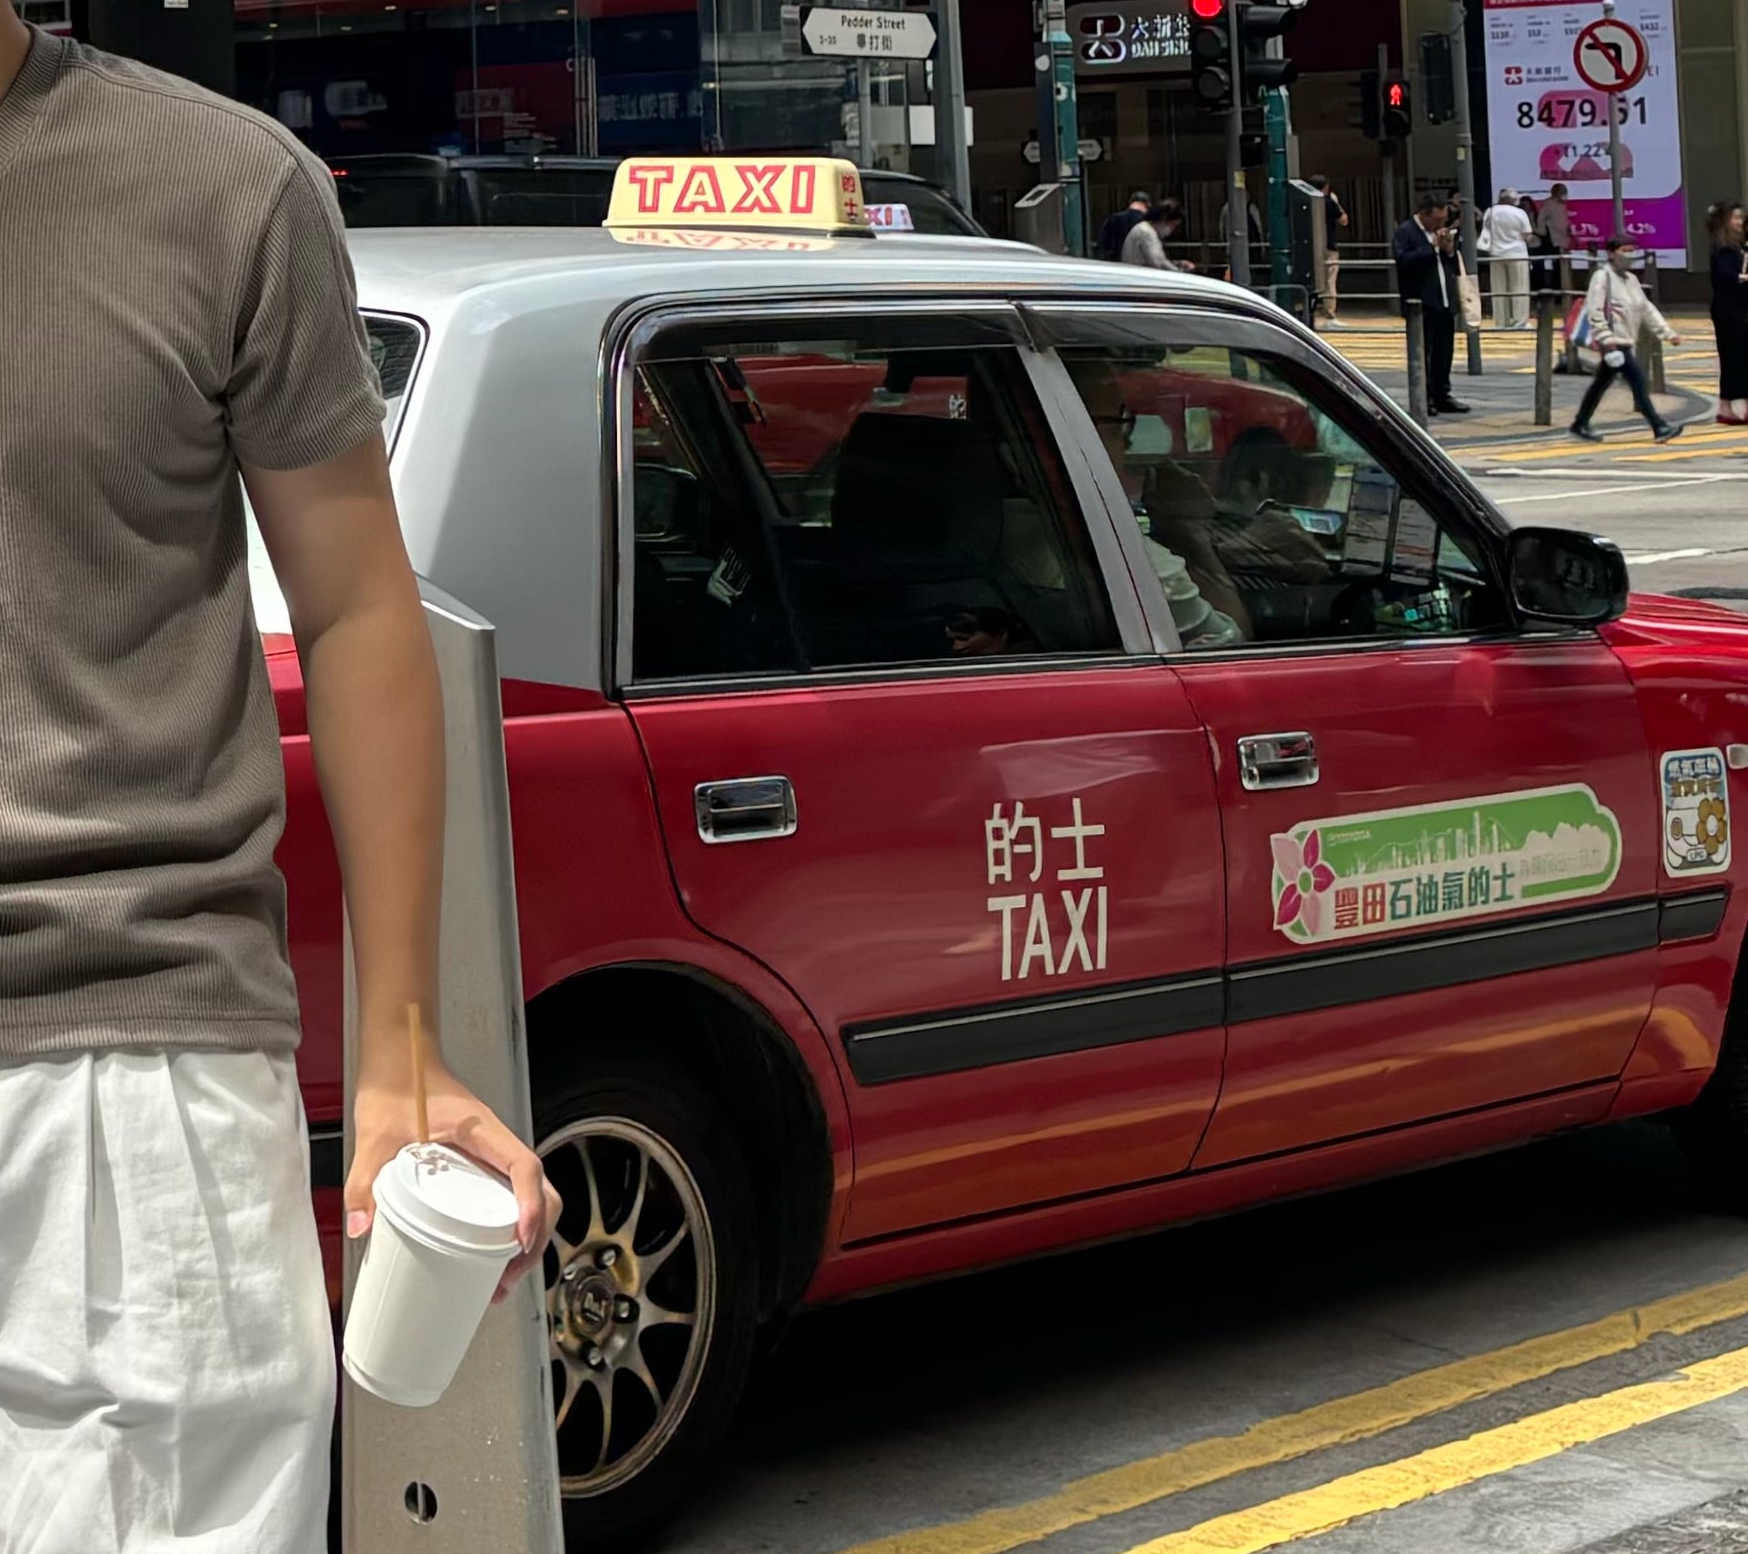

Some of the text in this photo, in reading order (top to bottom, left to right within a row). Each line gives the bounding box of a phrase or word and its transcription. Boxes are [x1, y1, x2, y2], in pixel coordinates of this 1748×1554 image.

[841, 15, 906, 30] Pedder Street
[628, 164, 816, 214] TAXI
[984, 797, 1106, 885] 的士
[987, 885, 1108, 981] TAXI
